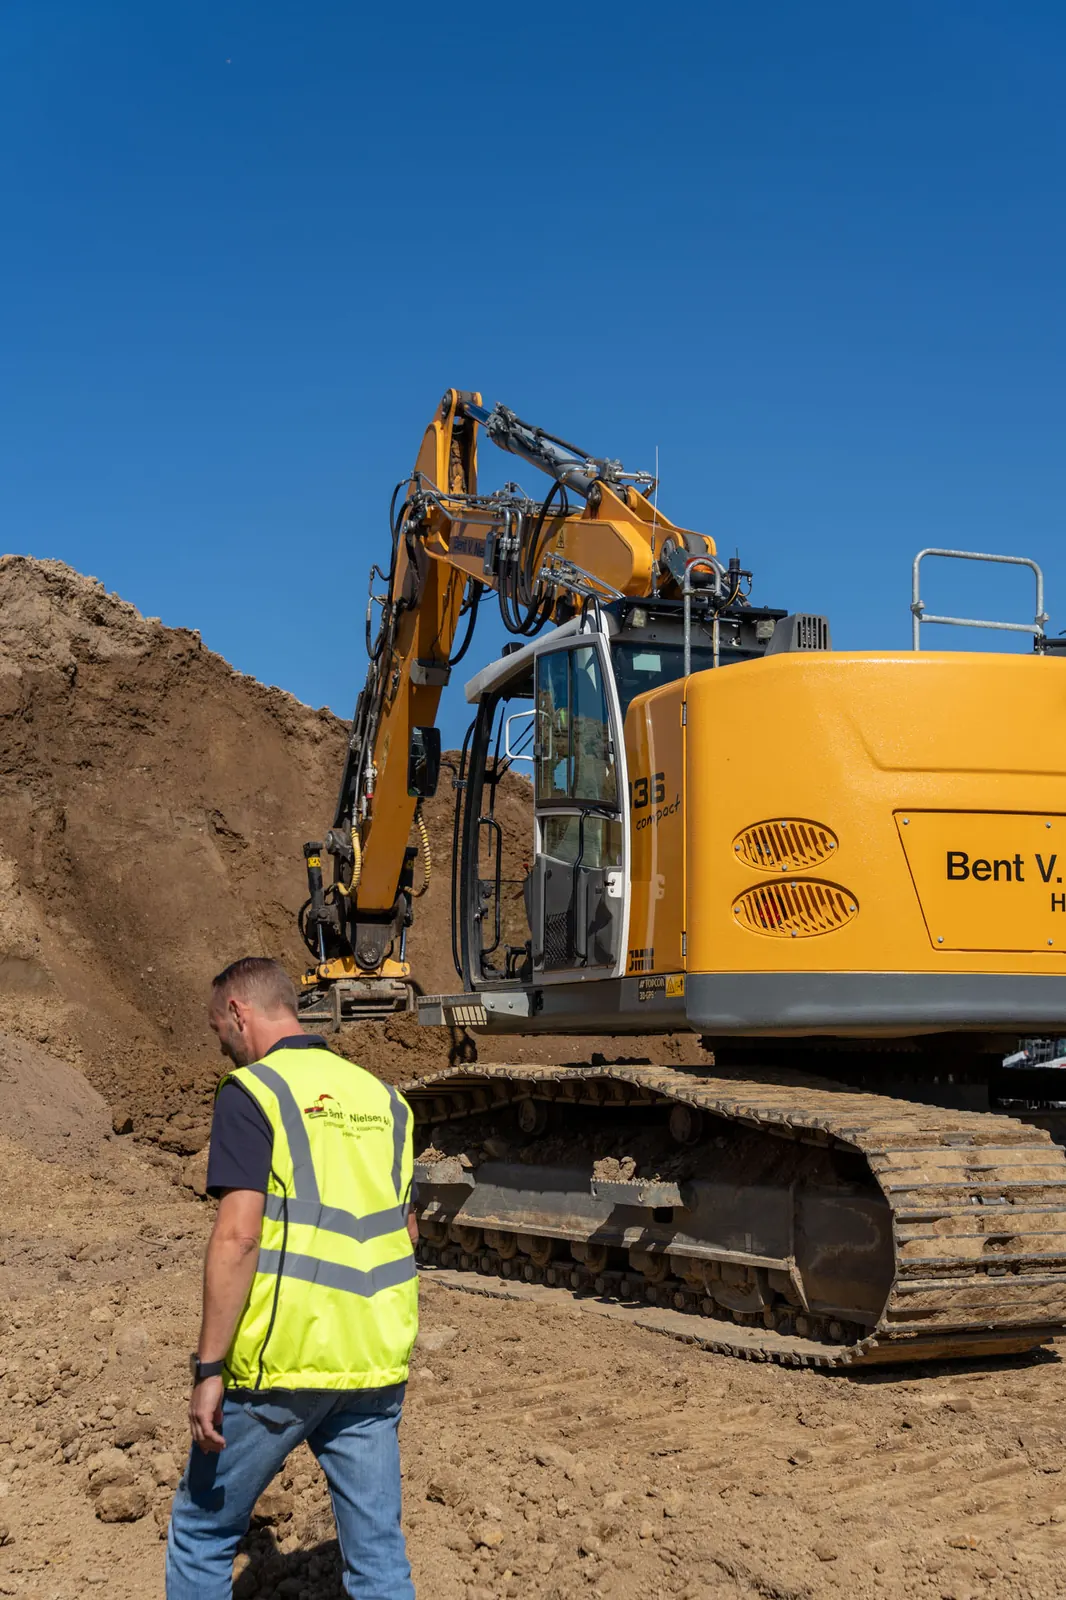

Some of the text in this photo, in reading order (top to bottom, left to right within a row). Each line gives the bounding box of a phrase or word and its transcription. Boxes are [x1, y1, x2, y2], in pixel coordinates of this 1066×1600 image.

[628, 772, 665, 809] 36
[636, 792, 681, 830] compact
[946, 851, 1063, 883] Bent V.
[349, 1112, 382, 1123] Nielsen
